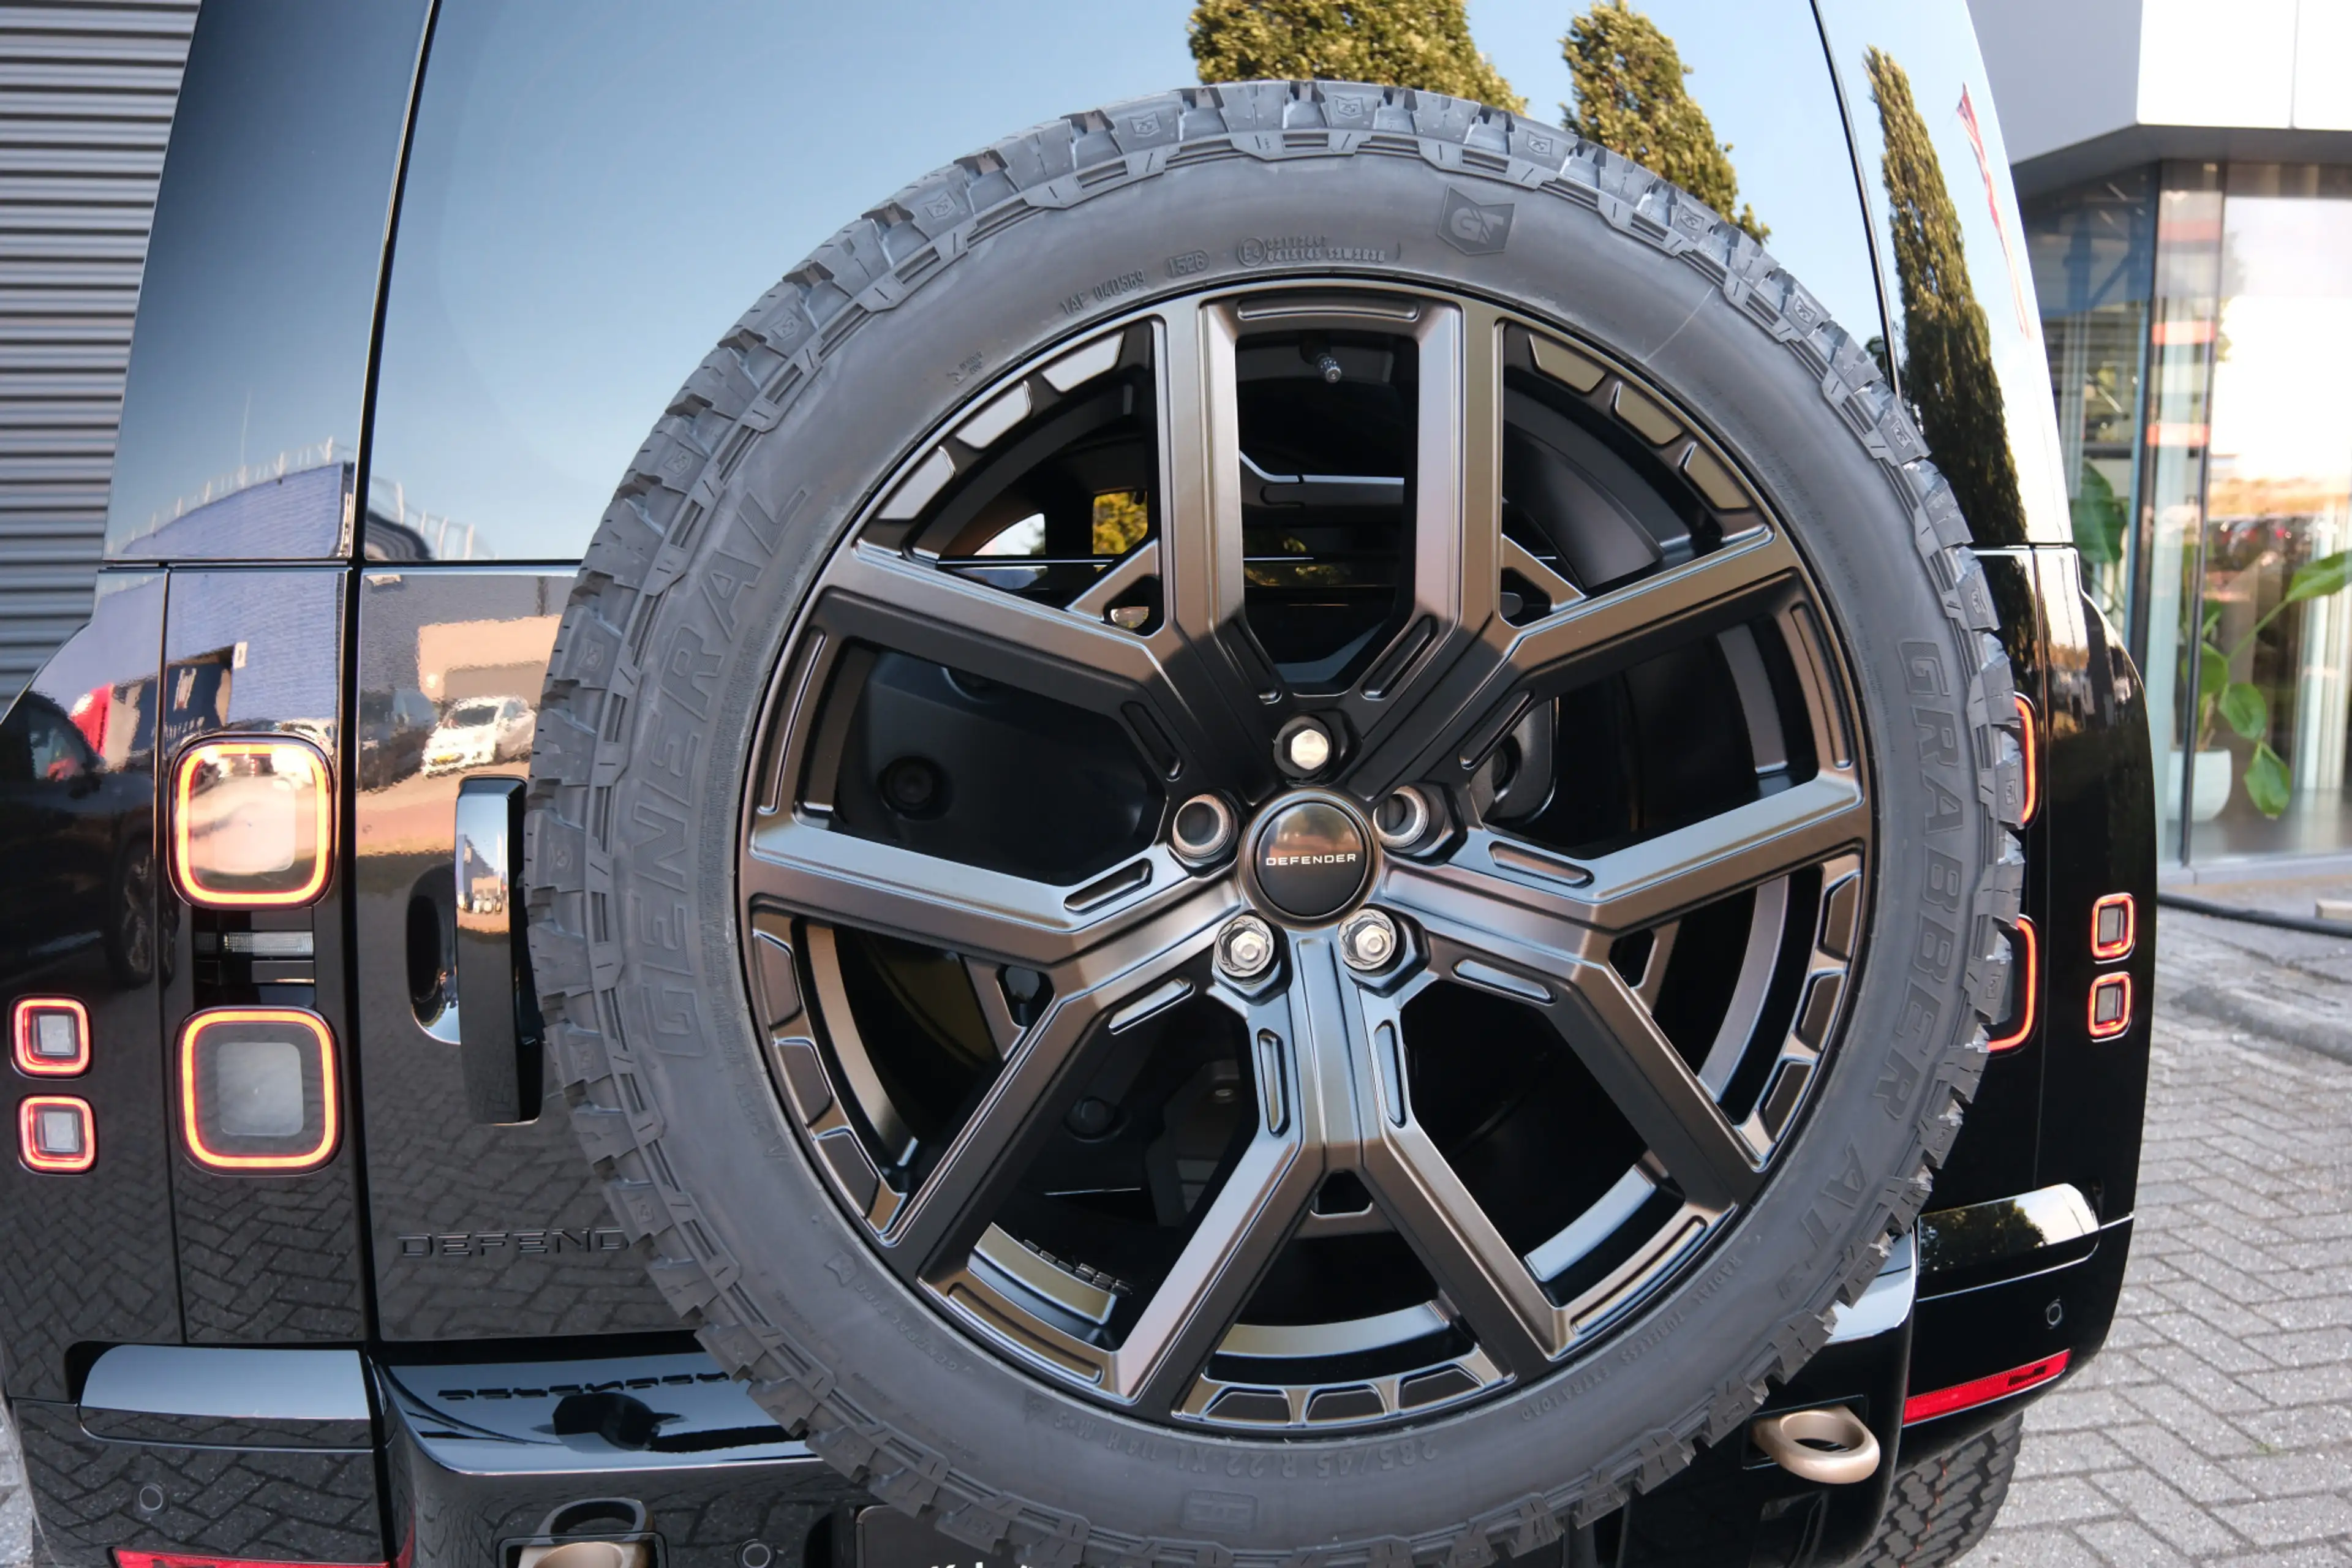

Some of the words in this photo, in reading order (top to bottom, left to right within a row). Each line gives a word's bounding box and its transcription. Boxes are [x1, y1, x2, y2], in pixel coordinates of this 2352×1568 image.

[1167, 253, 1205, 276] 1526
[630, 488, 809, 1058] GENERAL
[1265, 853, 1357, 866] DEFENDER
[1873, 637, 1964, 1123] GRABBER
[397, 1227, 630, 1256] DEFEND
[1692, 1256, 1743, 1306] RADIAL
[854, 1282, 888, 1315] TIRE
[892, 1316, 958, 1370] GENERAL
[1619, 1308, 1686, 1366] TUBELESS
[1561, 1365, 1611, 1395] EXTRA
[1521, 1395, 1561, 1421] LOAD
[1176, 1445, 1212, 1473] XL
[1226, 1449, 1267, 1479] 22
[1281, 1450, 1298, 1478] R
[1316, 1439, 1439, 1479] 285/45
